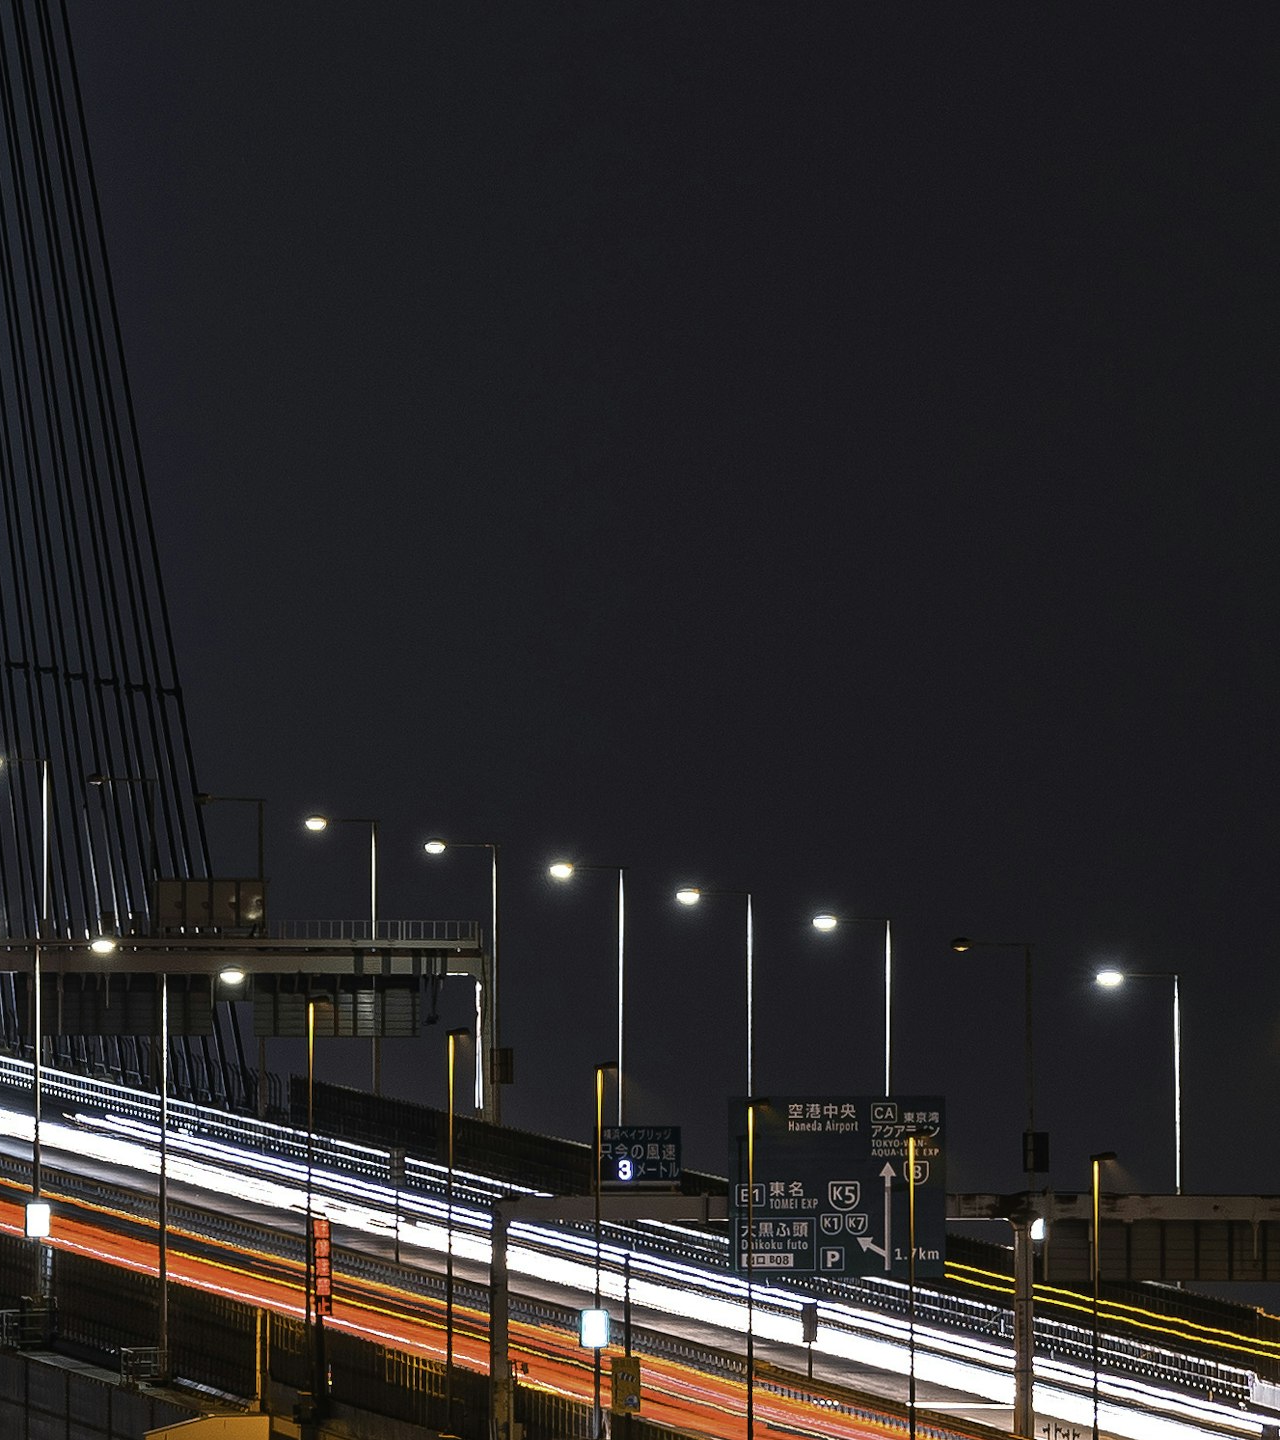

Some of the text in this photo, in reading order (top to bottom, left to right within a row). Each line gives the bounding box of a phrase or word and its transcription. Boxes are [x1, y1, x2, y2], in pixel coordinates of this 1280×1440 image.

[788, 1103, 856, 1119] 空港中央
[874, 1107, 894, 1119] CA
[903, 1112, 939, 1124] 東京湾
[788, 1121, 859, 1133] Haneda Airport
[600, 1143, 676, 1160] 只今の風速
[618, 1160, 632, 1181] 3
[741, 1188, 759, 1203] E1
[769, 1181, 804, 1197] 東名
[833, 1186, 856, 1204] K5
[769, 1198, 819, 1209] TOMEI EXP
[740, 1221, 809, 1237] 大黒ふ頭
[824, 1217, 838, 1230] K1
[848, 1217, 865, 1230] K7
[786, 1239, 809, 1250] futo
[826, 1251, 840, 1267] P
